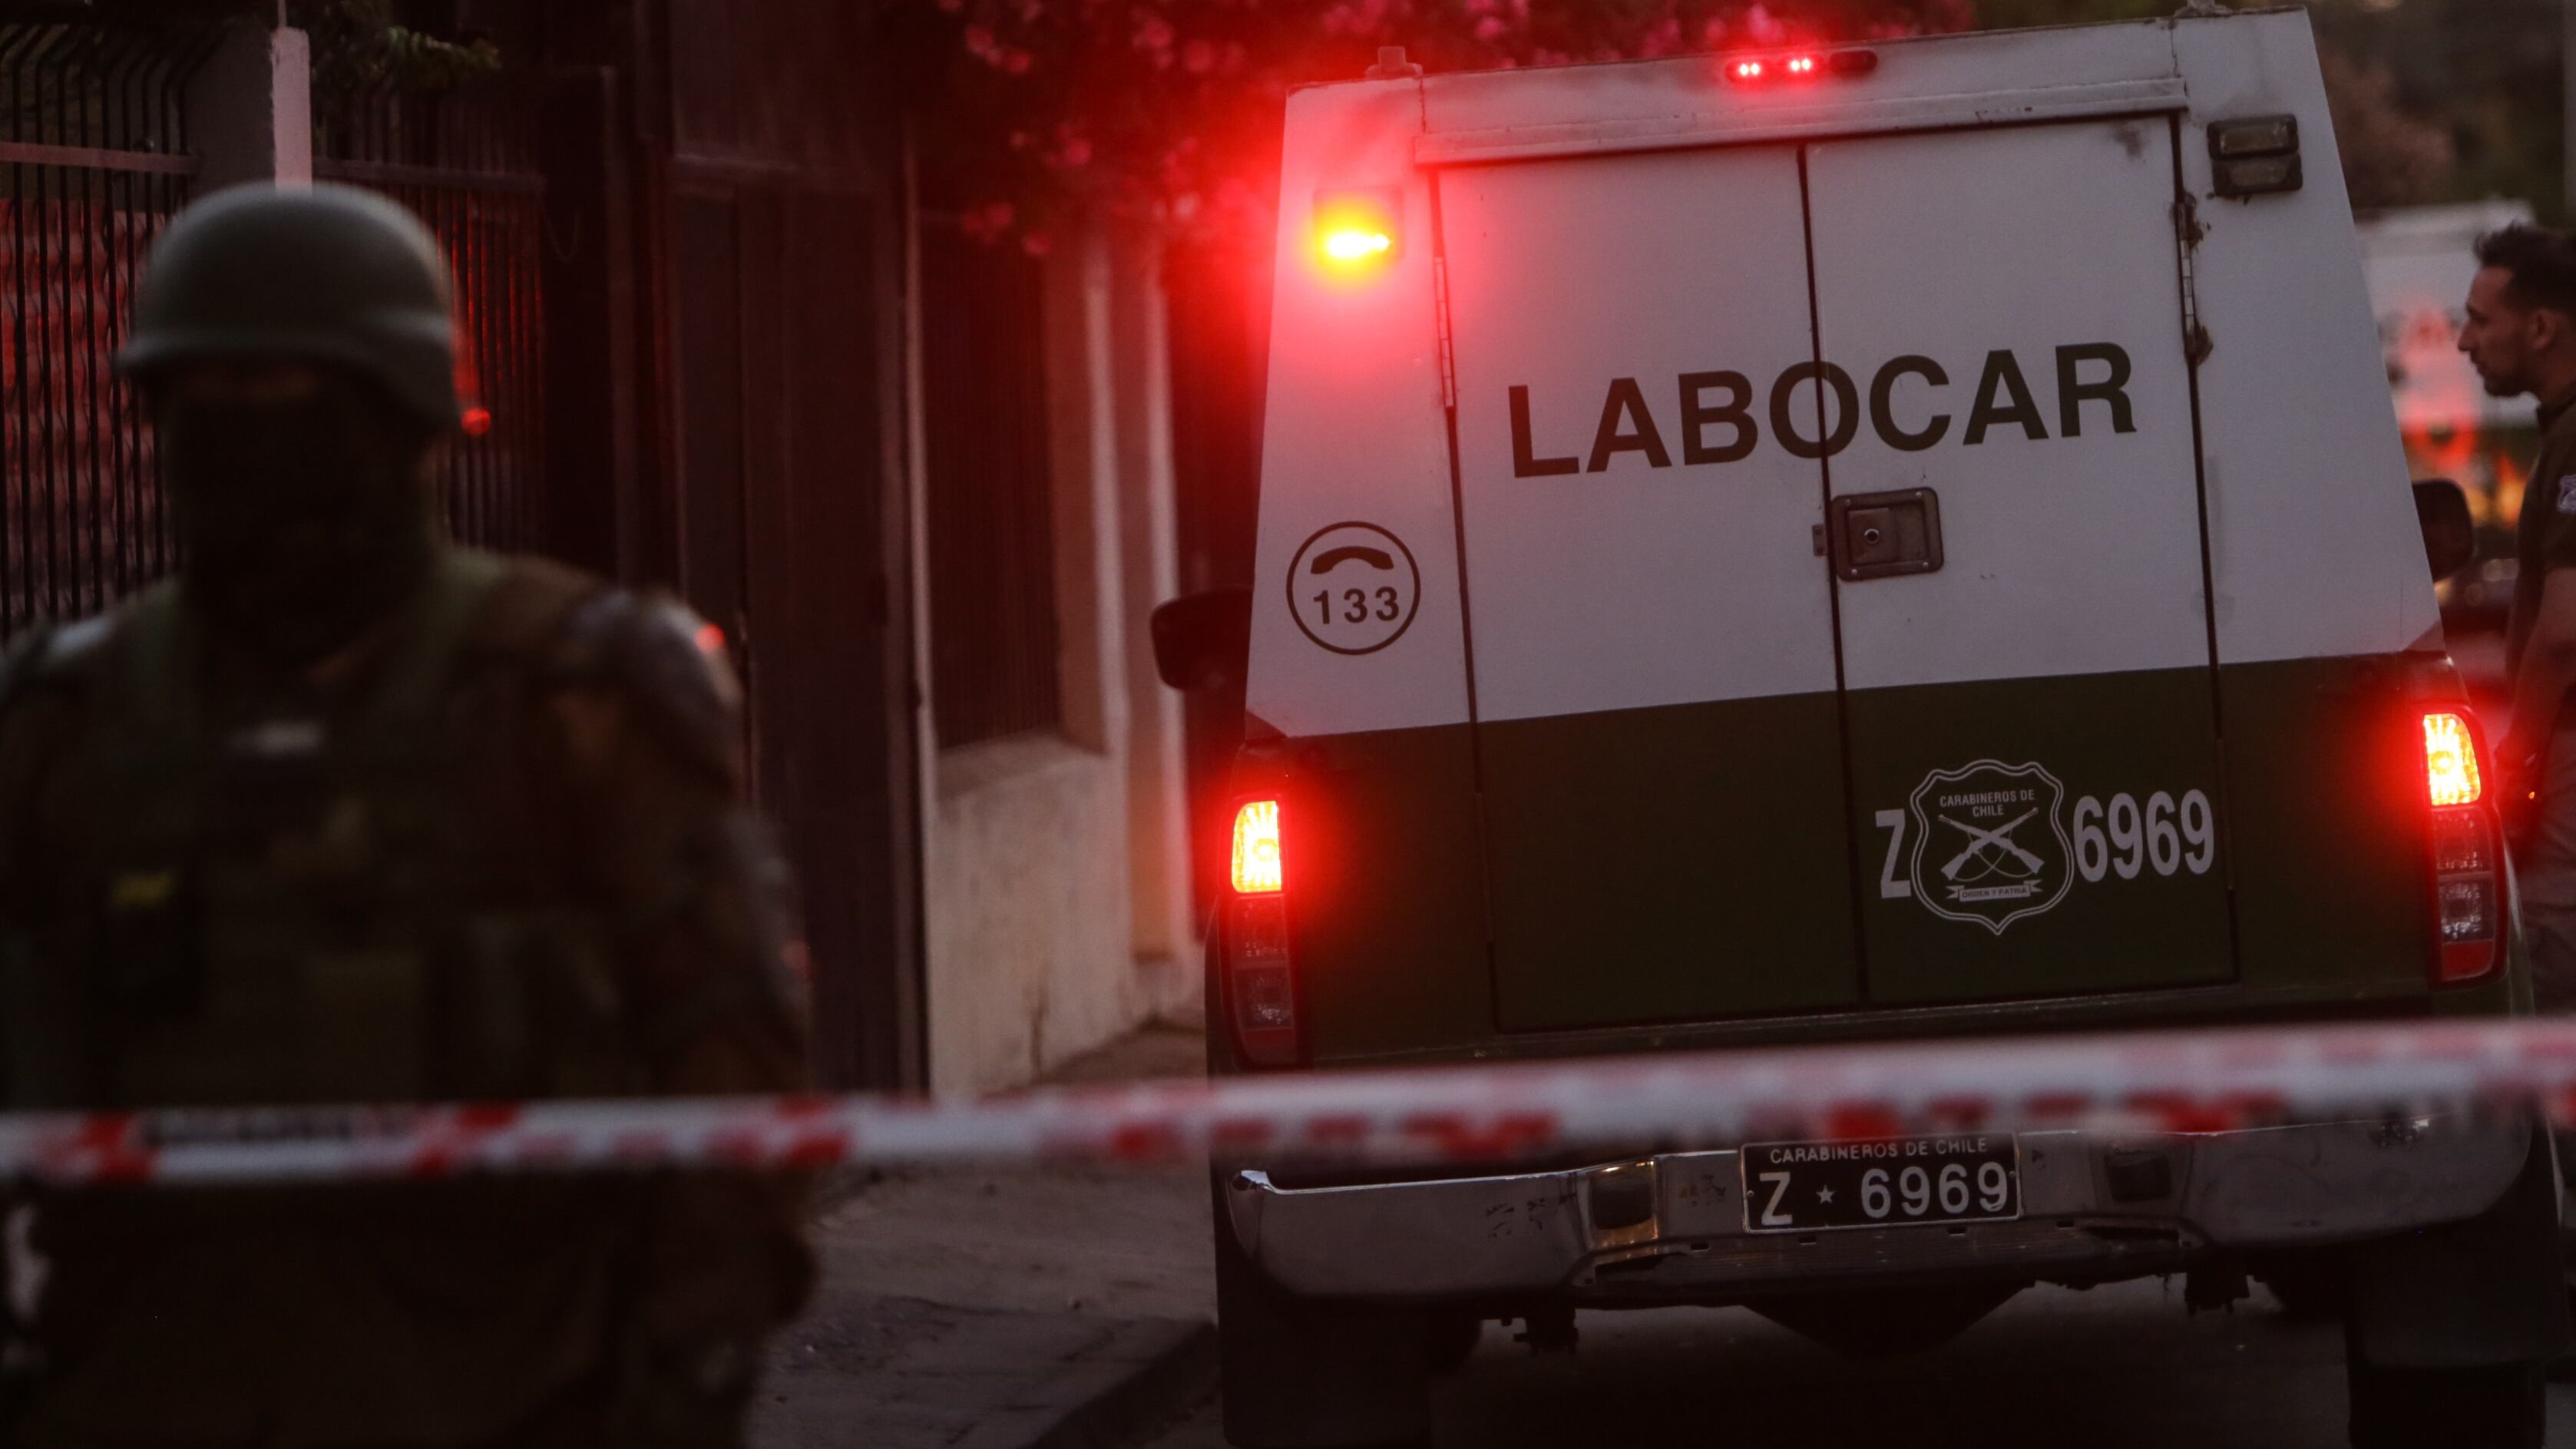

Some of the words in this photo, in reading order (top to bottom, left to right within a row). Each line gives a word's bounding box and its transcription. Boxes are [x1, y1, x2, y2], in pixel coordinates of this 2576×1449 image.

[1509, 342, 2137, 478] LABOCAR
[1313, 586, 1399, 624] 133
[1939, 790, 2017, 808] CARABINEROS
[2020, 789, 2035, 801] DE
[1973, 804, 2004, 818] CHILE
[1874, 808, 1912, 899] Z
[2072, 788, 2215, 883] 6969
[1770, 1141, 1899, 1164] CARABINEROS
[1906, 1140, 1929, 1157] DE
[1936, 1136, 1988, 1155] CHILE
[1758, 1171, 1794, 1226] Z
[1860, 1161, 2009, 1219] 6969
